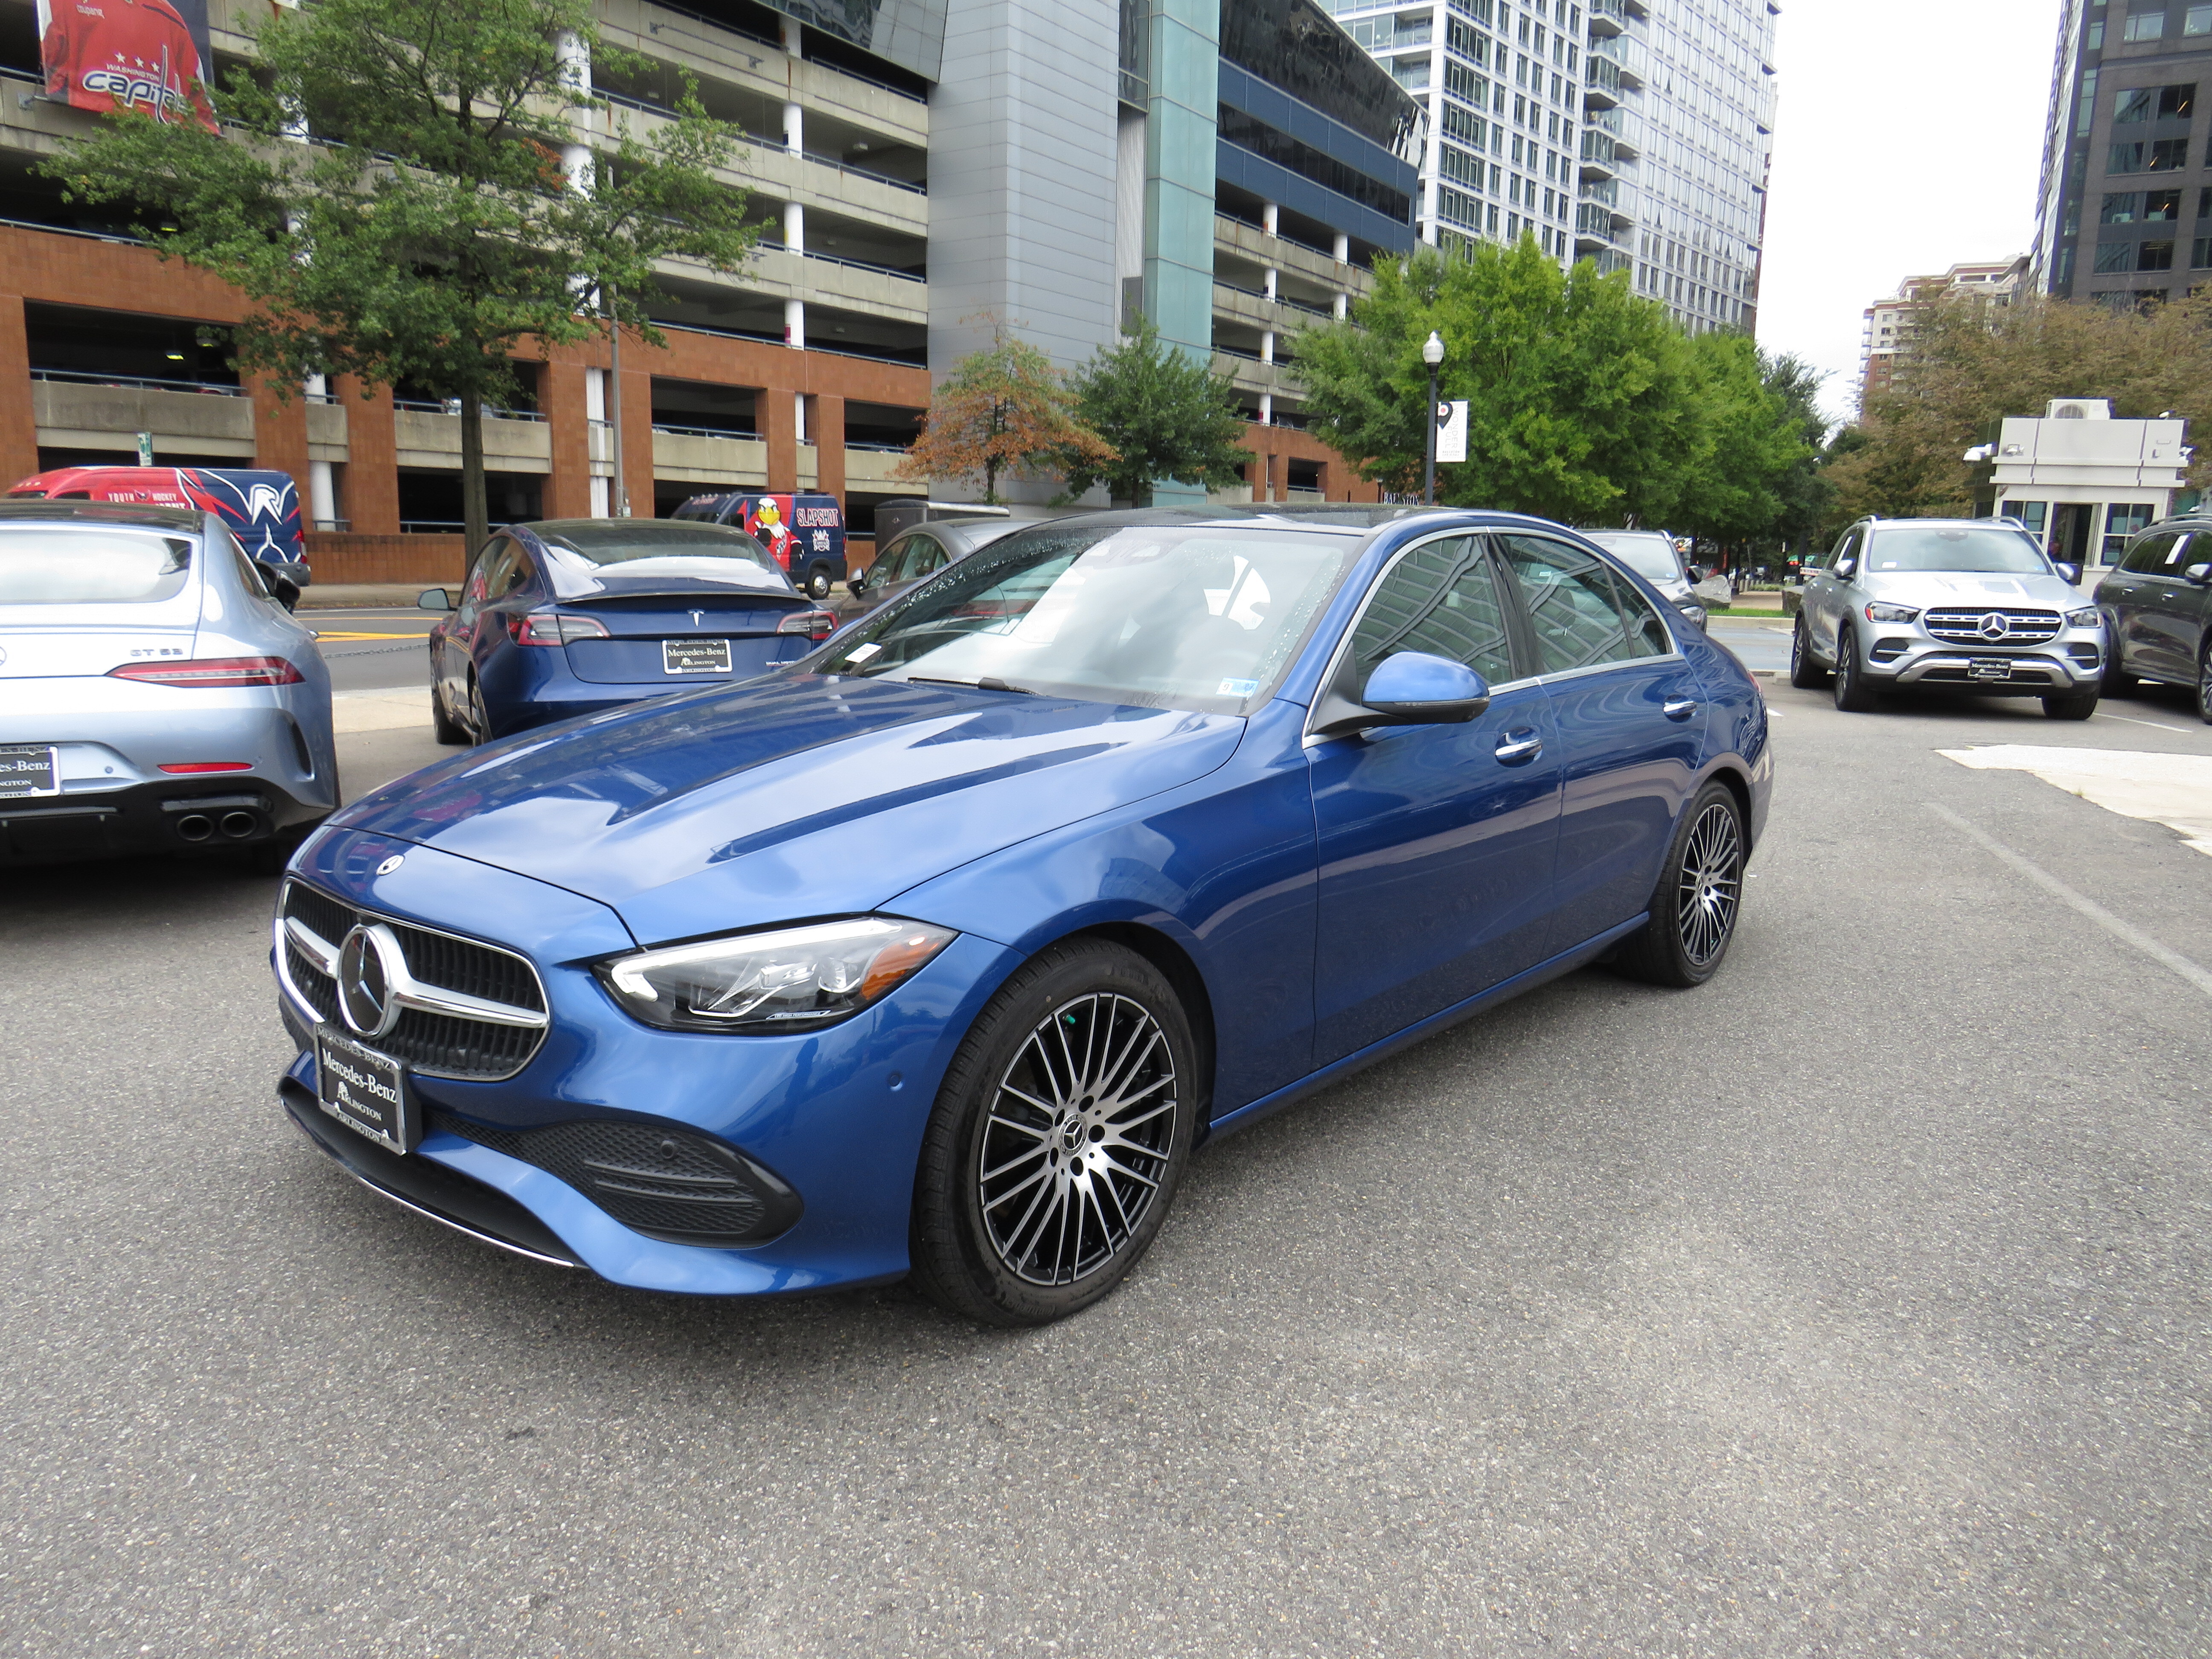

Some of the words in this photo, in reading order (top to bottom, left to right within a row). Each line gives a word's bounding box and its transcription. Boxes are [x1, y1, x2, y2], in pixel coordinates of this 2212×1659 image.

[107, 64, 160, 81] WASHINGTON
[108, 492, 135, 503] YOUTH
[152, 493, 177, 501] HOCKEY
[796, 508, 838, 527] SLAPSHOT
[667, 647, 726, 658] Mercedes-Benz
[318, 1027, 391, 1070] MERCEDES-BENZ
[322, 1048, 397, 1103] Mercedes-Benz
[337, 1081, 382, 1121] ARLINGTON
[338, 1113, 381, 1144] ARLINGTON
